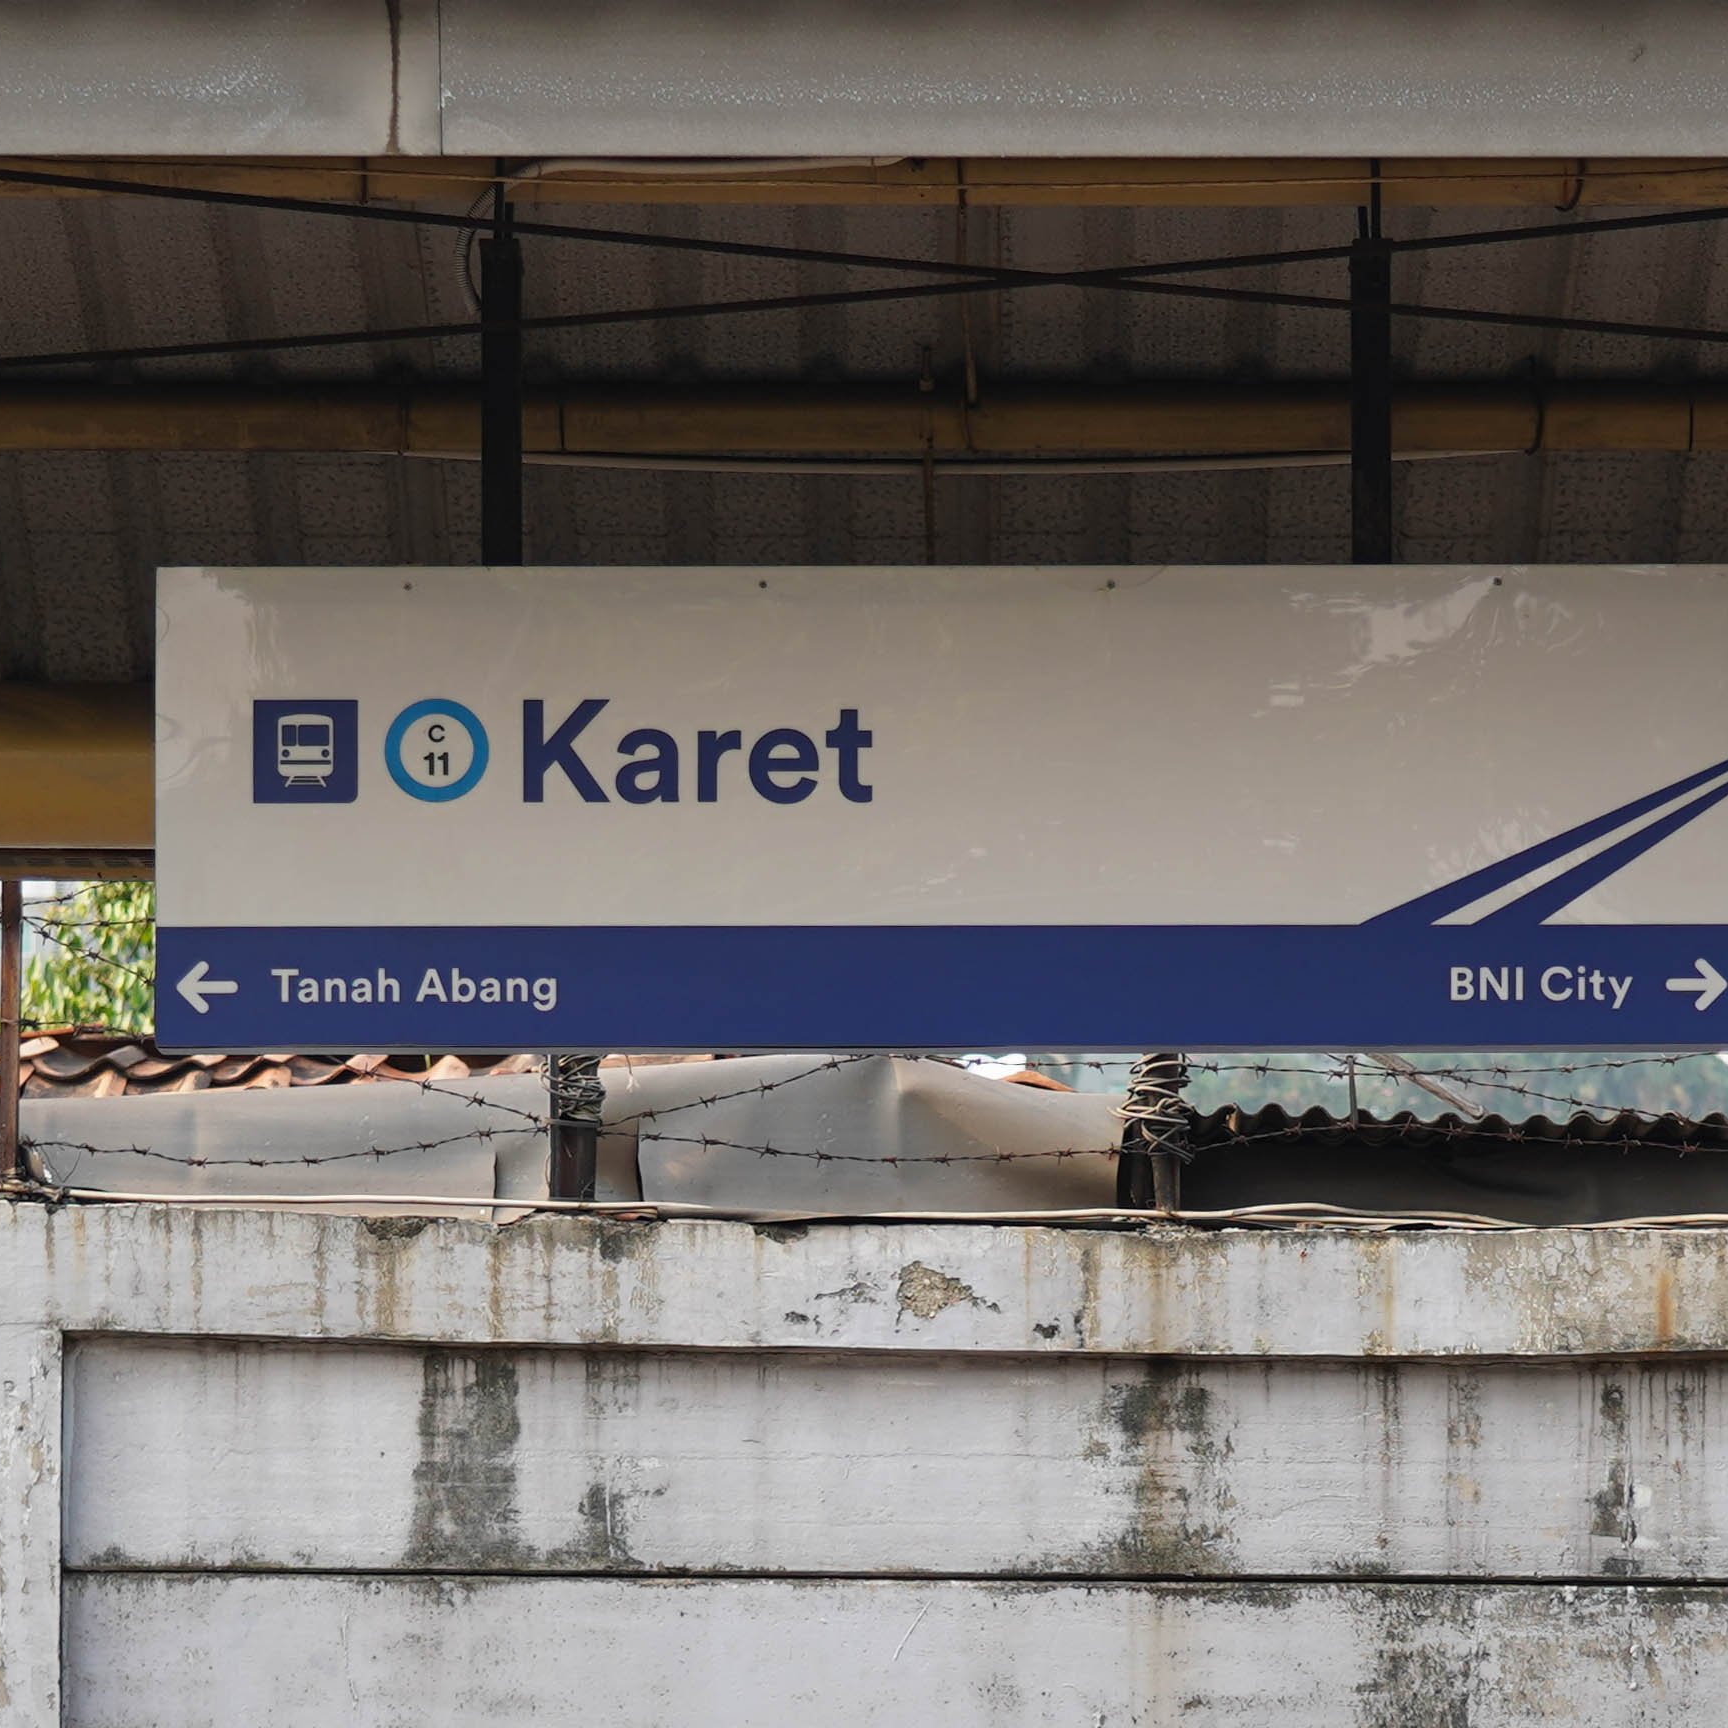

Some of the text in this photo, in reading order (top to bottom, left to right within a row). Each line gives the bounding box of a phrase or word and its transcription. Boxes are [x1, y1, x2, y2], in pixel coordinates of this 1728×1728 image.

[427, 723, 446, 744] C
[522, 698, 873, 805] Karet
[422, 751, 450, 777] 11
[271, 967, 558, 1012] Tanah Abang
[1450, 965, 1634, 1009] BNI City
